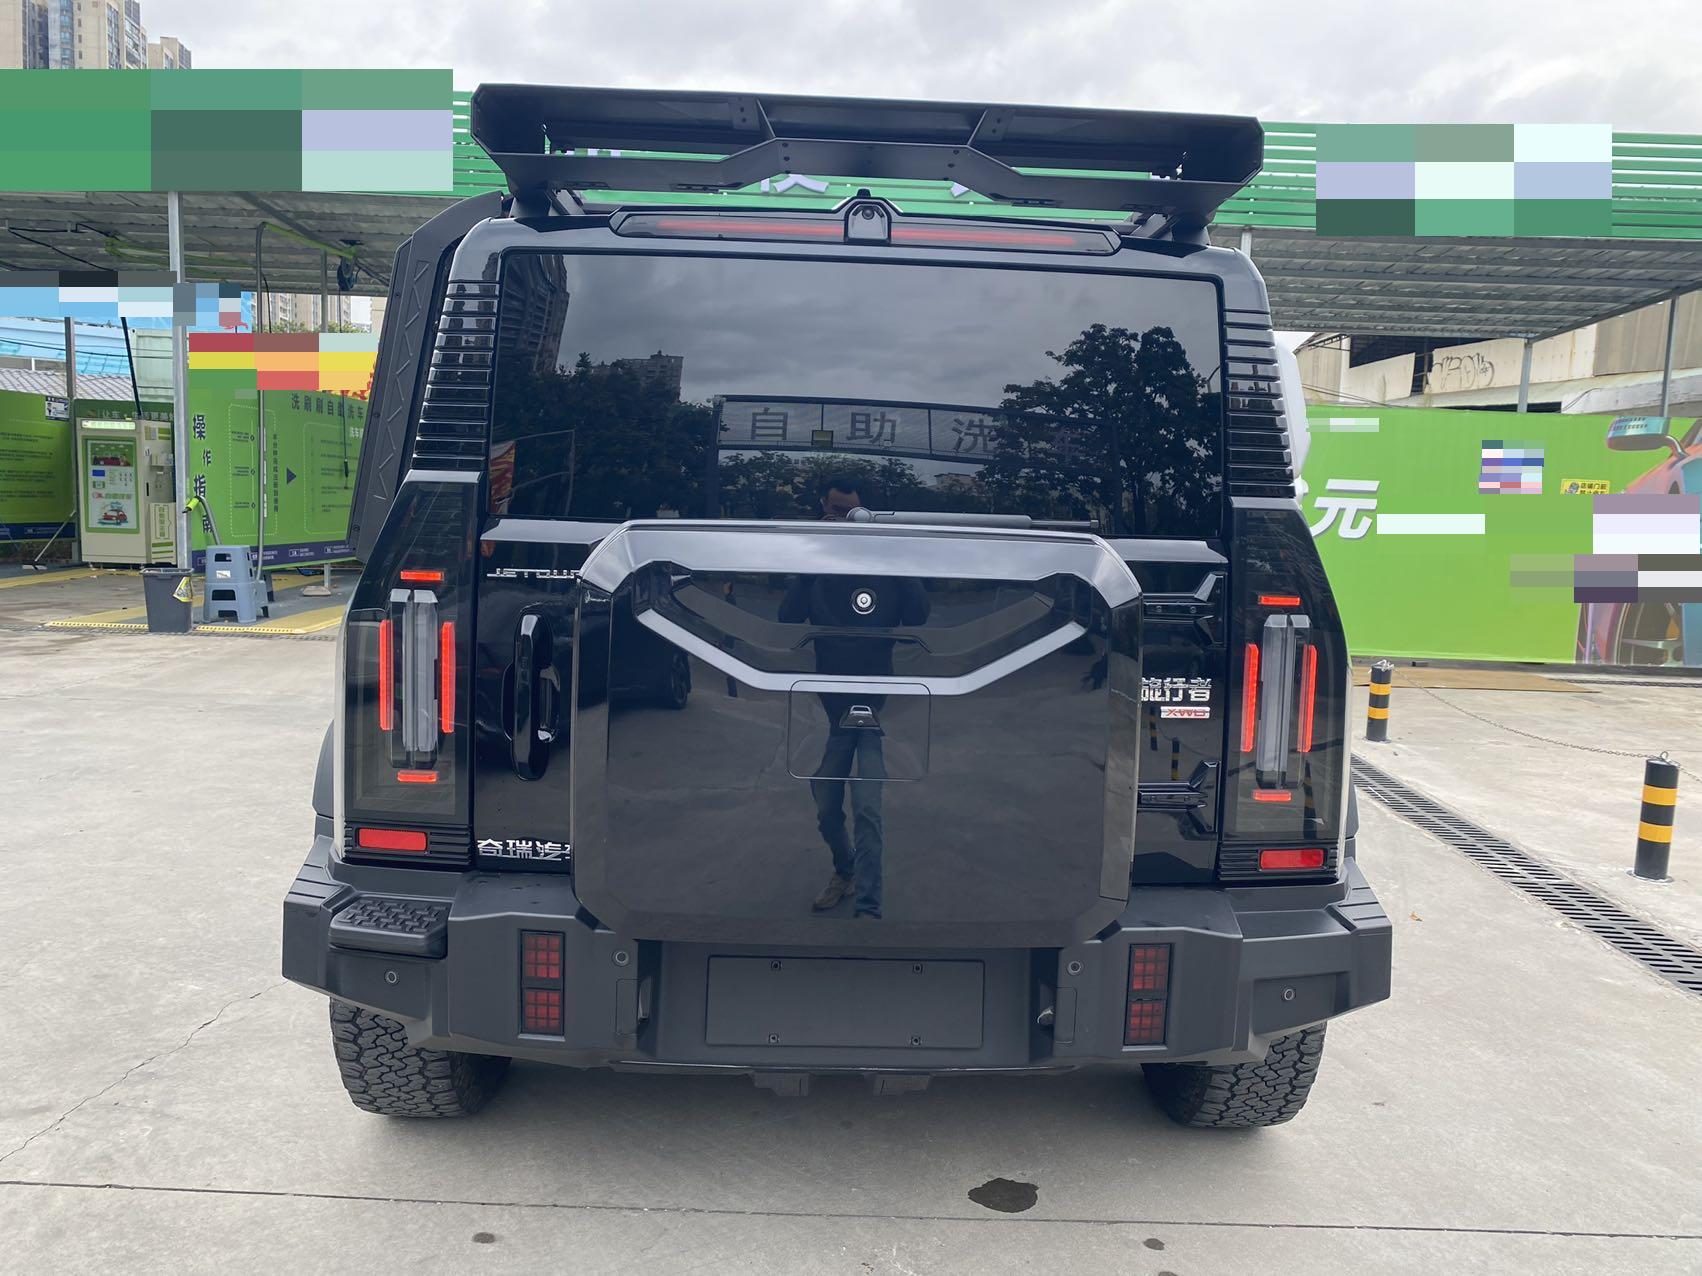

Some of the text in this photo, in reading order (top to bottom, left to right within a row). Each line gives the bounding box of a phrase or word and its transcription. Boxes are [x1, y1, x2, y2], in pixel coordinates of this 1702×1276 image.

[1309, 479, 1380, 539] 元
[477, 838, 571, 861] 奇瑞汽
